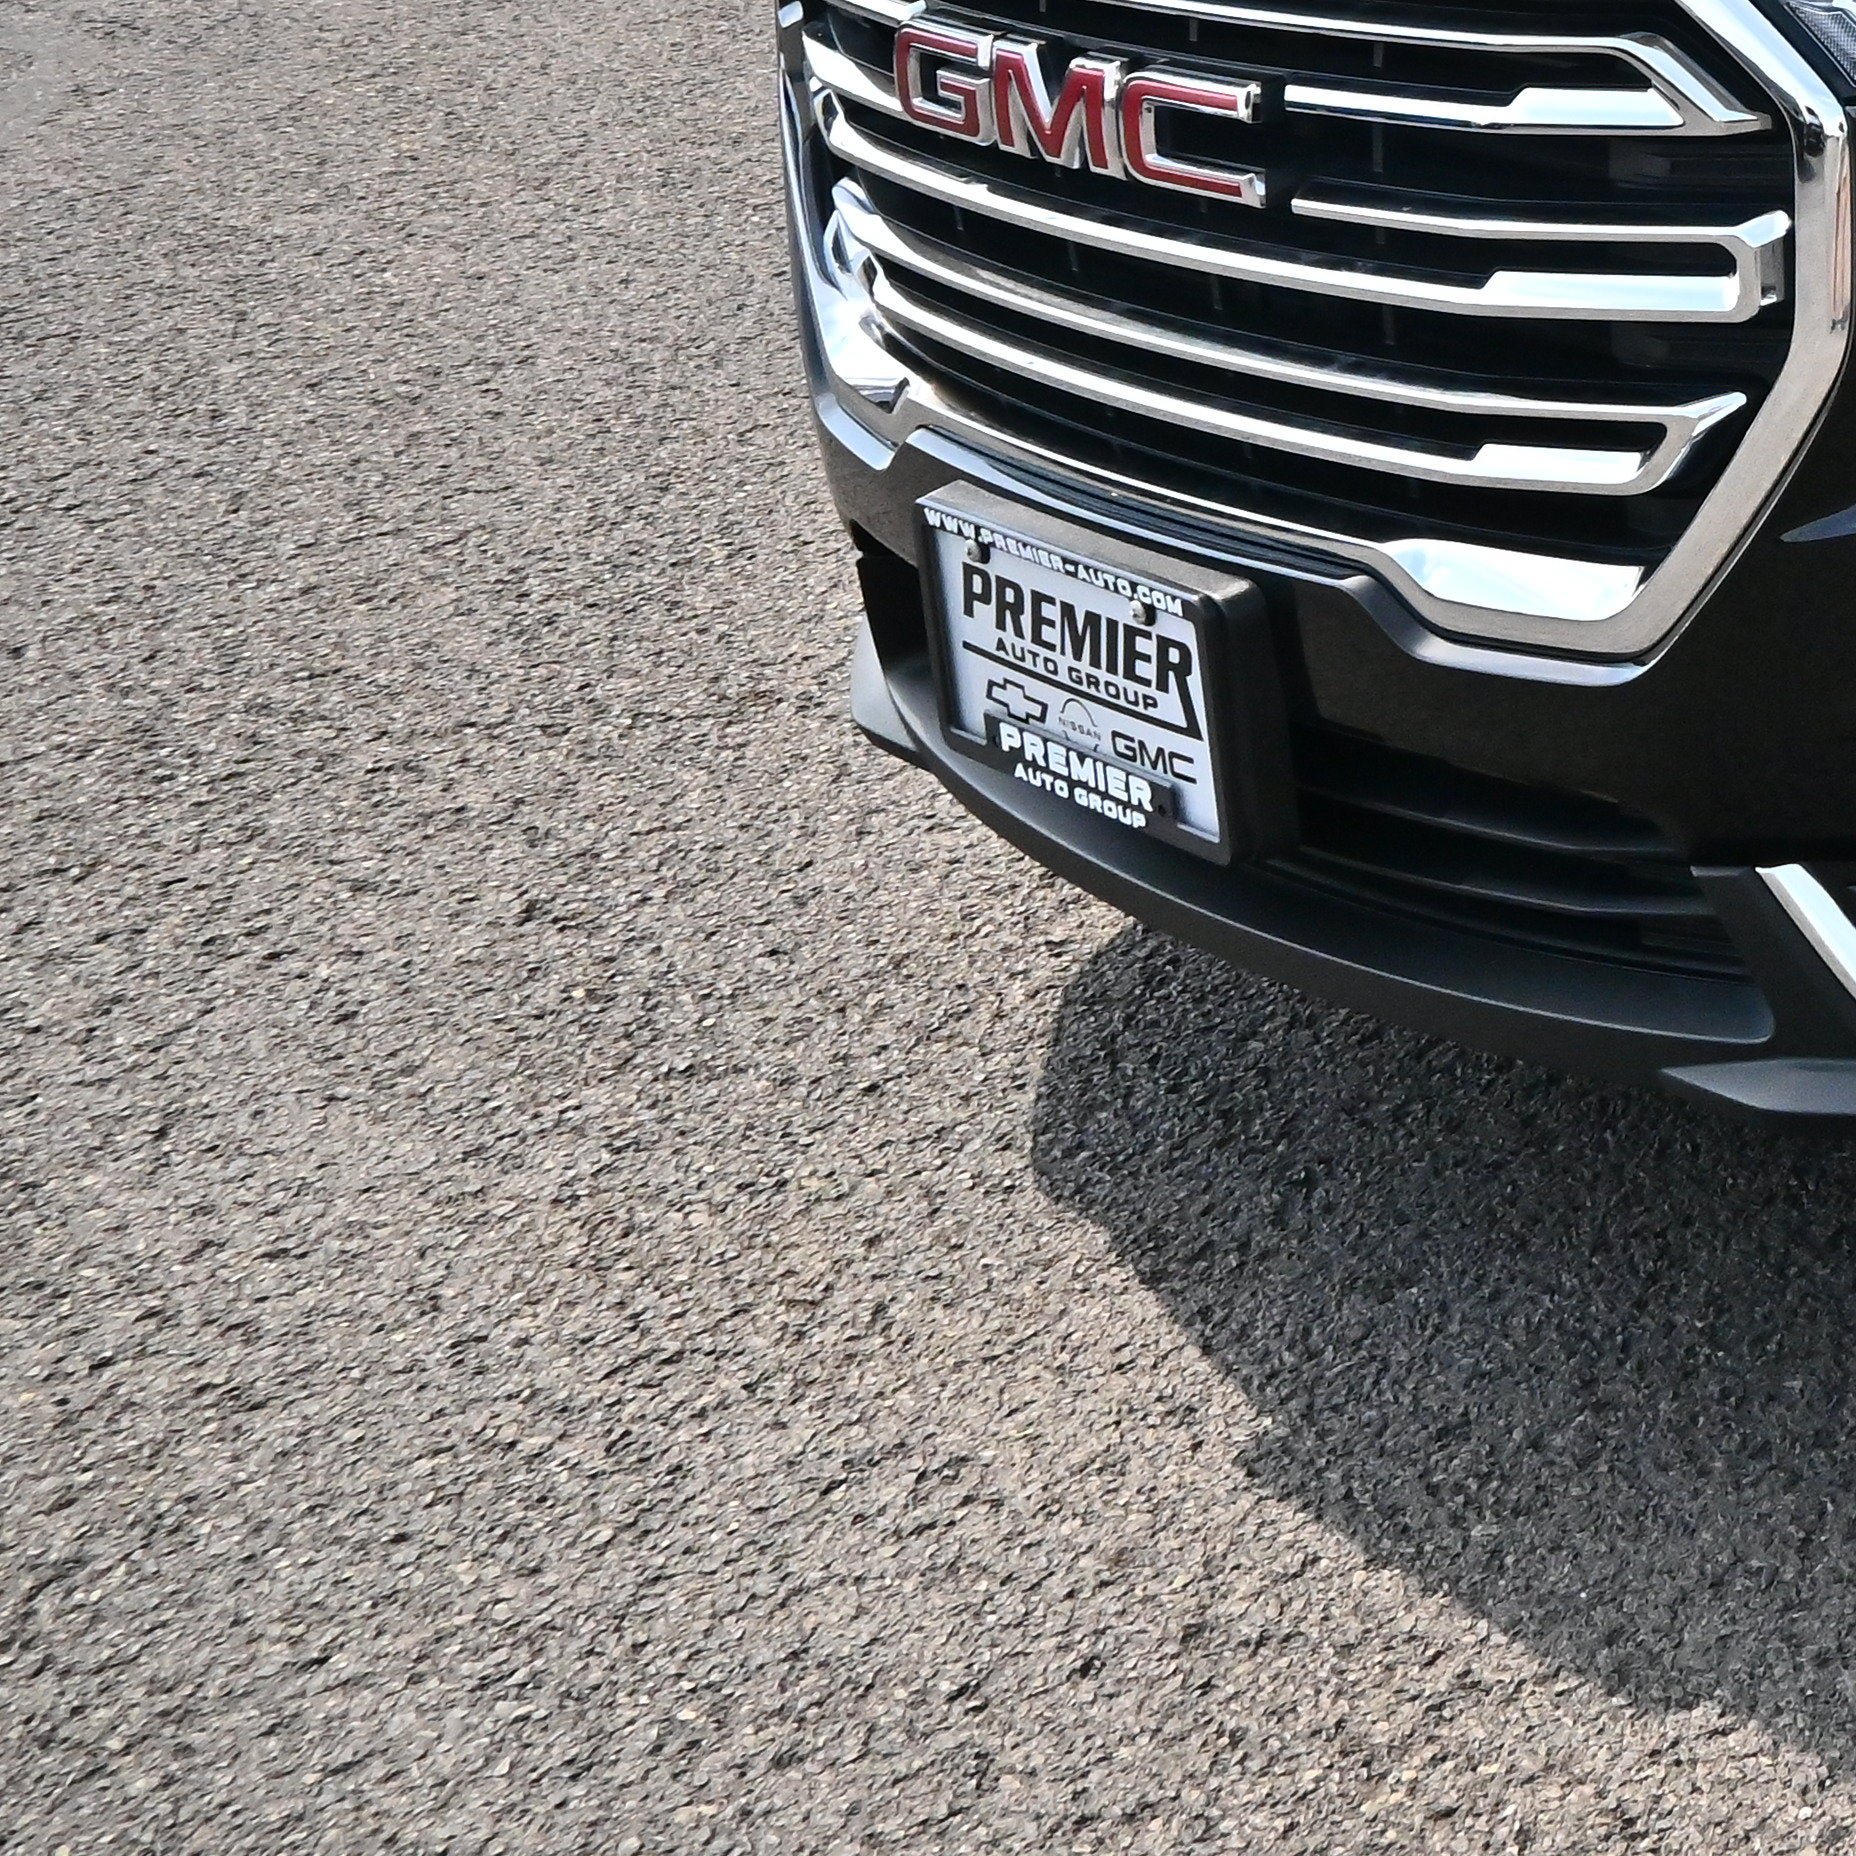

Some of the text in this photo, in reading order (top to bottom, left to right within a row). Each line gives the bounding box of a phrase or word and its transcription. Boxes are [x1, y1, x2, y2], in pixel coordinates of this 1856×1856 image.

[894, 12, 1268, 209] GMC
[923, 507, 1184, 618] WWW.PREMIER-AUTO.COM
[962, 561, 1195, 696] PREMIER
[995, 636, 1159, 713] AUTO GROUP
[999, 723, 1154, 812] PREMIER
[1058, 717, 1102, 741] NISSAN
[1110, 729, 1199, 785] GMC
[1014, 762, 1148, 830] AUTO GROUP
